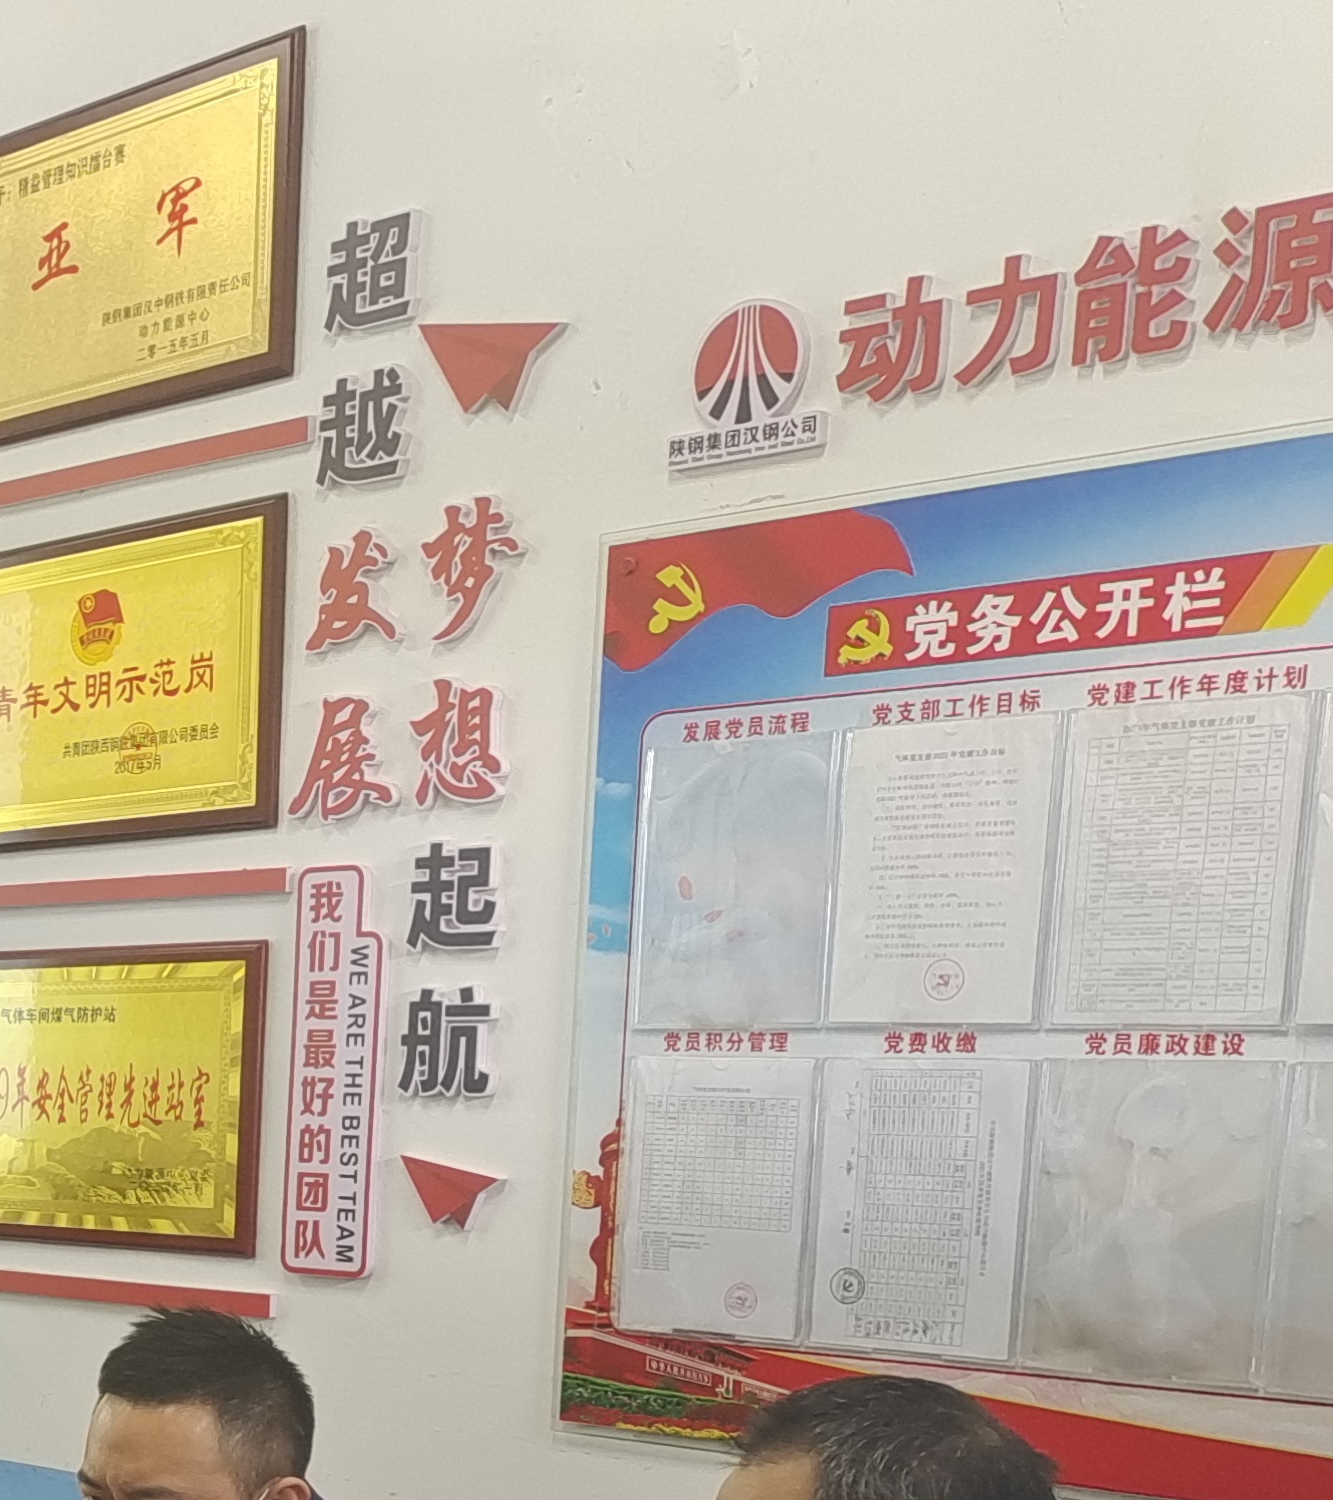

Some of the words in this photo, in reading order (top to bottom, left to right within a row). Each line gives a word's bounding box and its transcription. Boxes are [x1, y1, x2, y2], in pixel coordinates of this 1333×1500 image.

[32, 177, 202, 291] 亚军
[836, 192, 1333, 402] 动力能源
[669, 414, 817, 459] 陕钢集团汉钢公司
[904, 567, 1228, 661] 党务公开栏
[872, 689, 1042, 727] 党支部工作目标
[1087, 664, 1308, 709] 党建工作年度计划
[683, 712, 810, 744] 发展党员流程
[348, 945, 370, 986] WE
[346, 992, 367, 1048] ARE
[663, 1030, 789, 1054] 党员积分管理
[883, 1030, 978, 1055] 党费收缴
[1084, 1031, 1247, 1058] 党员廉政建设
[294, 880, 344, 1260] 我们是最好的团队
[342, 1056, 364, 1107] THE
[339, 1116, 361, 1184] BEST
[335, 1190, 356, 1264] TEAM
